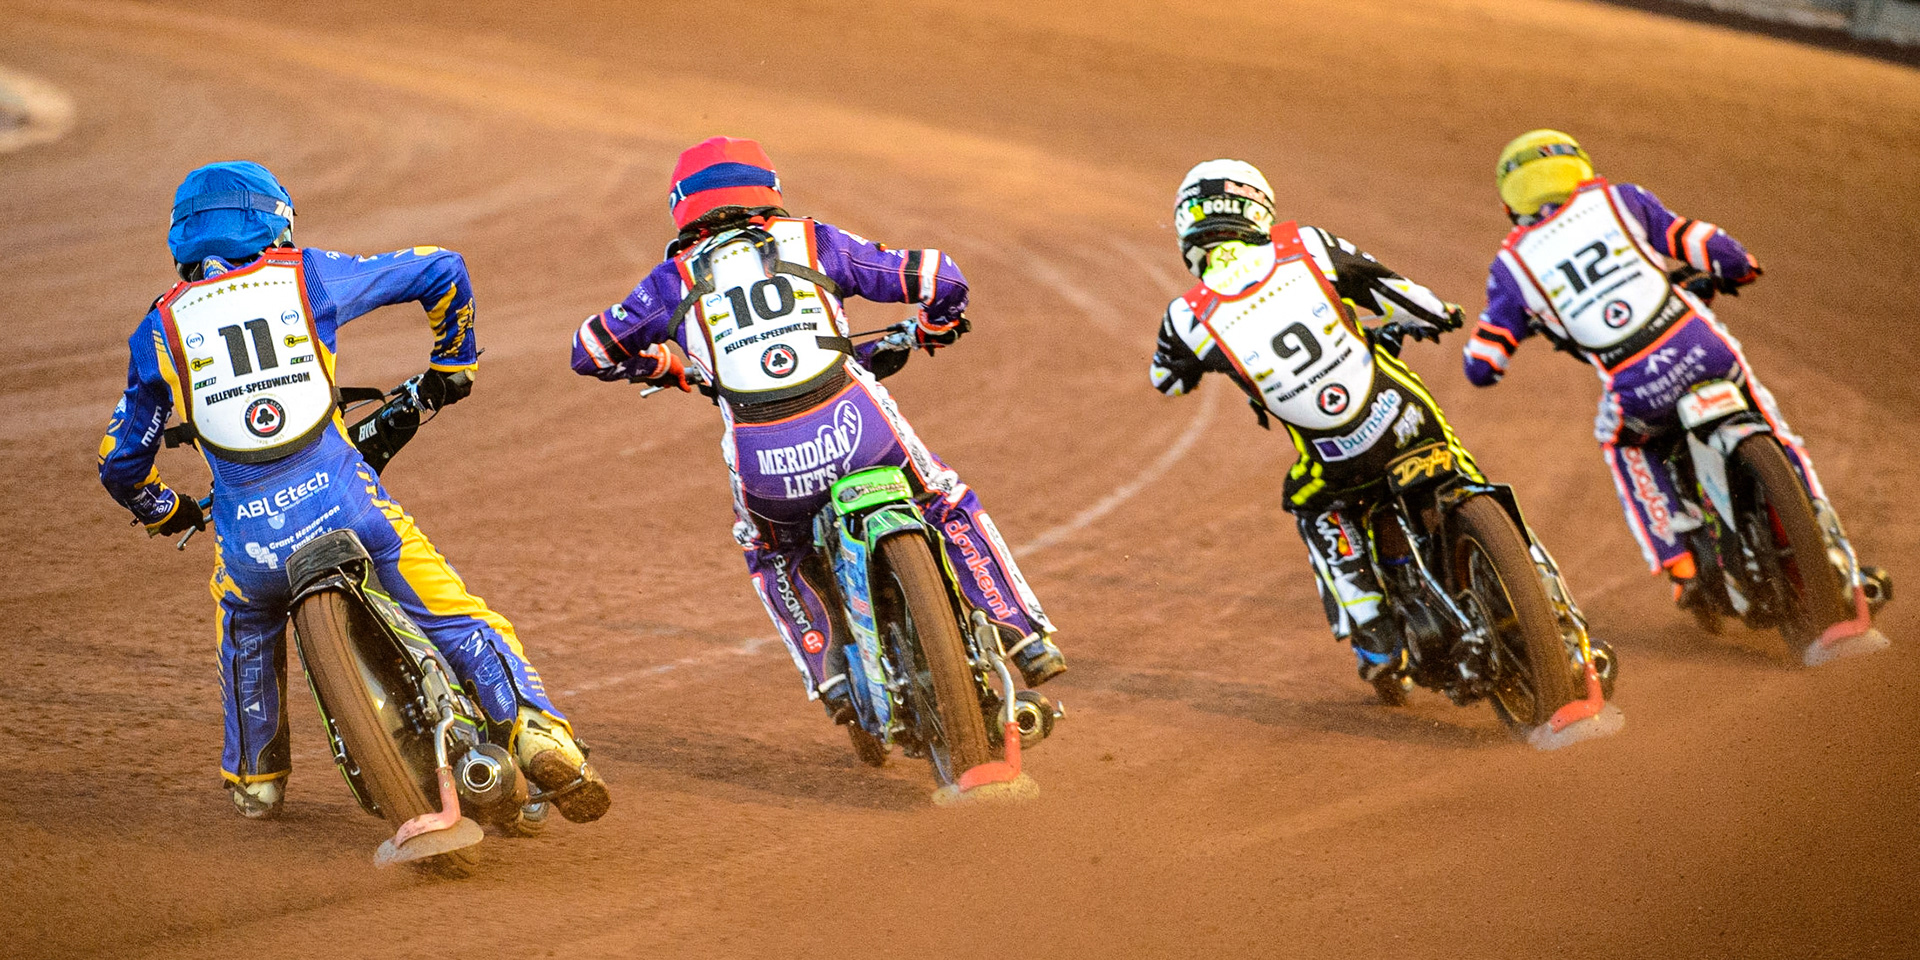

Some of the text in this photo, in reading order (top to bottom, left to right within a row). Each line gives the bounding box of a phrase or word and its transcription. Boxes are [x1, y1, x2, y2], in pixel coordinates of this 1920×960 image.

[1556, 240, 1620, 294] 12
[724, 275, 796, 330] 10
[218, 317, 279, 377] 11
[724, 322, 818, 355] BELLEVUE-SPEEDWAY.COM
[1270, 320, 1323, 377] 9
[204, 371, 311, 406] BELLEVUE-SPEEDWAY.COM
[1338, 391, 1397, 450] burnside
[756, 424, 851, 475] MERIDIAN
[783, 463, 839, 499] LIFTS
[268, 505, 341, 550] Grant Henderson
[945, 520, 1019, 620] dankemi
